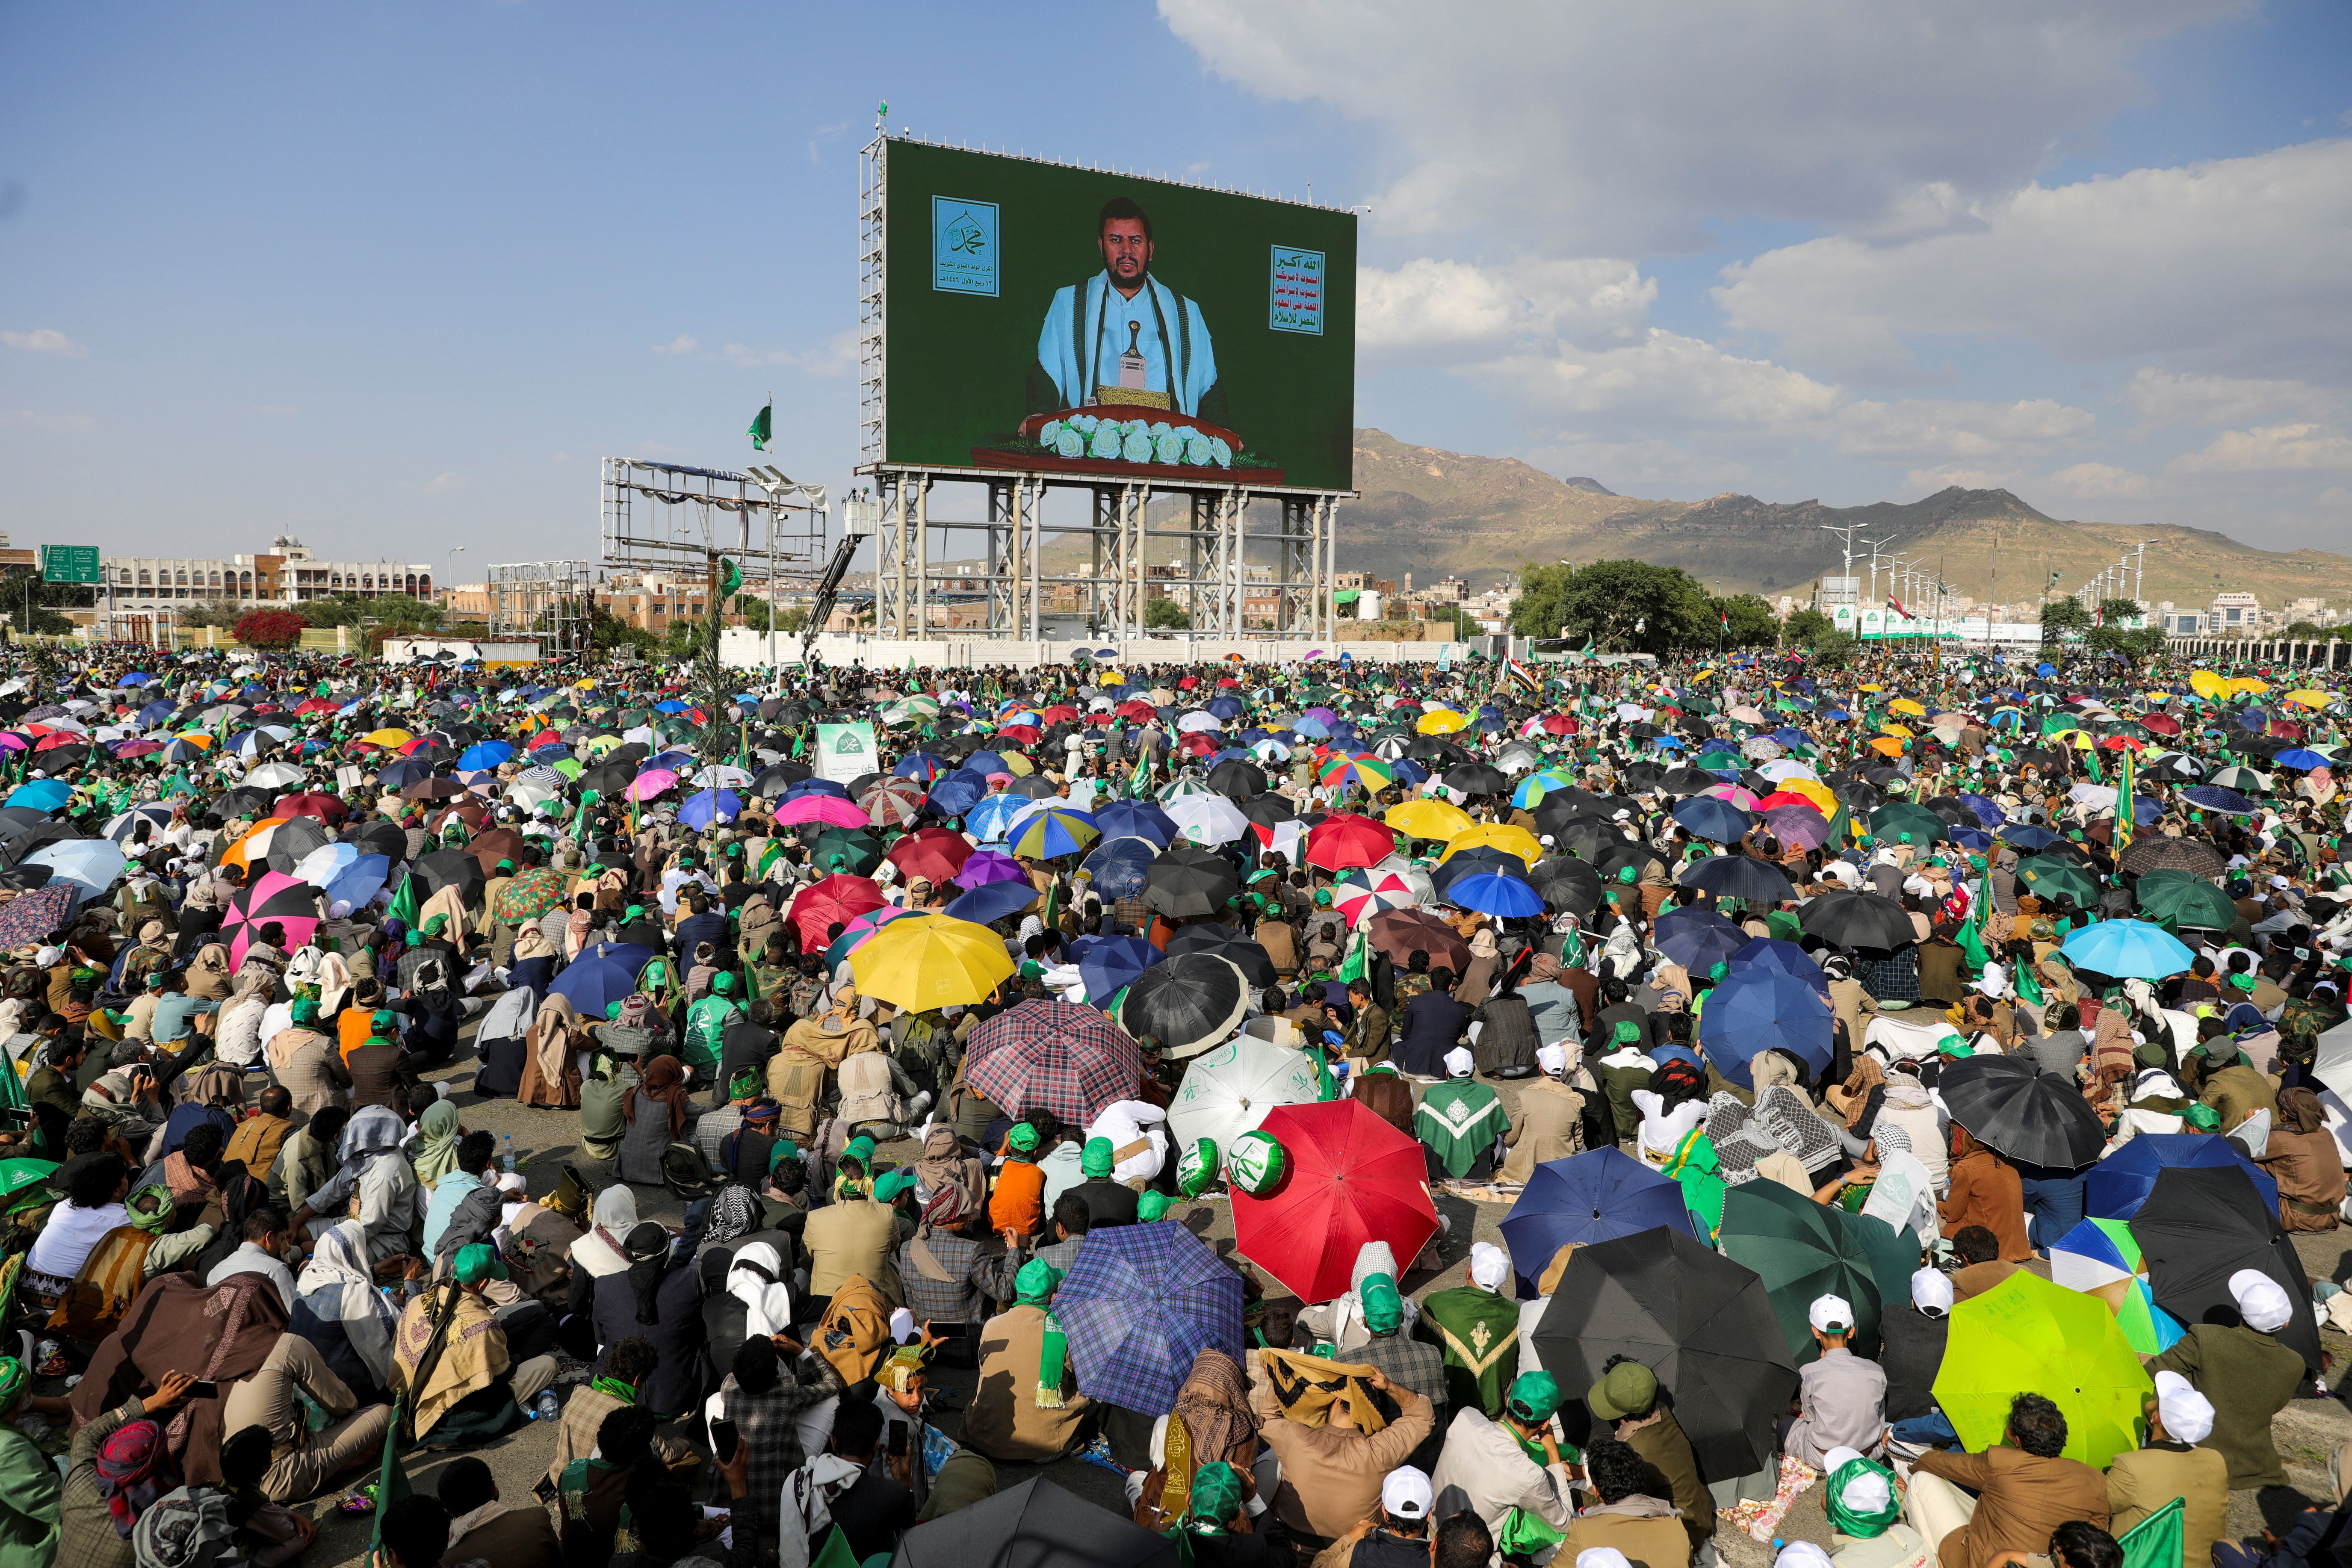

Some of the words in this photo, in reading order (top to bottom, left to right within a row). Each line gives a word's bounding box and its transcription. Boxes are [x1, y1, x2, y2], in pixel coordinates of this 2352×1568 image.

[1276, 253, 1303, 270] أكبر
[1303, 257, 1320, 270] الله
[1276, 269, 1299, 282] لأمريكا
[1301, 275, 1319, 285] الموت
[1275, 284, 1299, 298] لإسرائيل
[1300, 289, 1319, 298] الموت
[1274, 298, 1291, 310] اليهود
[1293, 301, 1302, 310] على
[1304, 301, 1318, 312] اللعنة
[1274, 310, 1297, 327] للإسلام
[1298, 313, 1318, 328] النصر
[861, 764, 875, 773] كن
[1209, 1047, 1232, 1064] SFHRP
